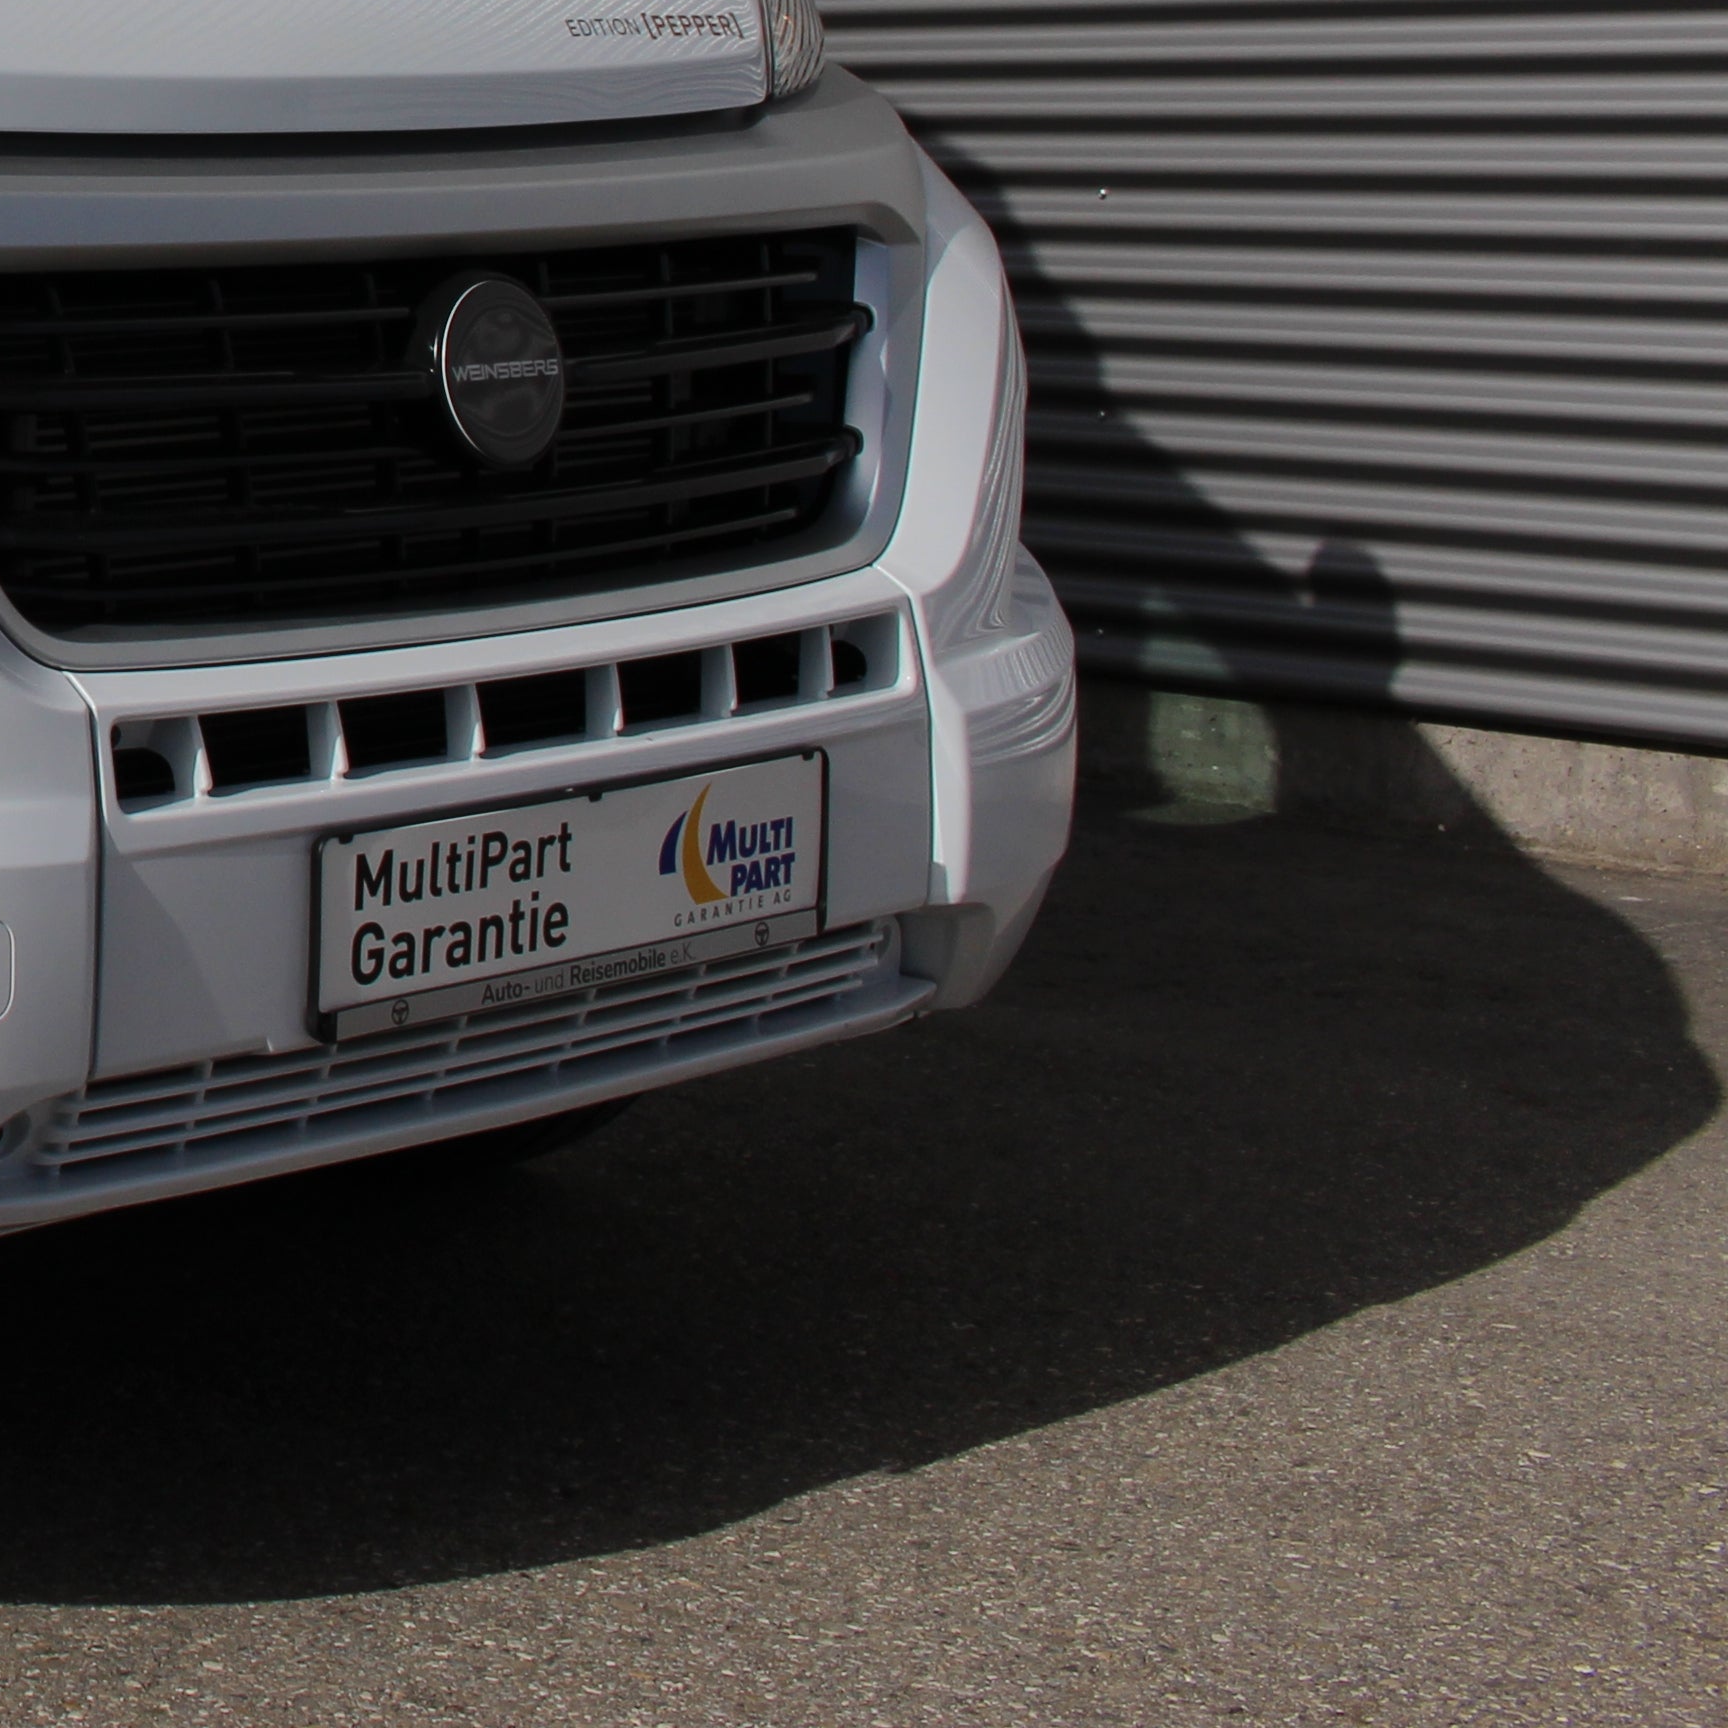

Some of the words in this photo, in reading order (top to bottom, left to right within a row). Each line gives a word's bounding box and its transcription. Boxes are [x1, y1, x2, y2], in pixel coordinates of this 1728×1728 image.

[564, 17, 641, 37] EDITION
[706, 816, 793, 866] MULTI
[354, 821, 573, 912] MultiPart
[730, 852, 796, 898] PART
[674, 895, 764, 927] GARANTIE
[773, 889, 792, 905] AG
[351, 892, 570, 986] Garantie
[481, 981, 531, 1005] Auto-
[534, 971, 565, 995] und
[570, 948, 666, 986] Reisemobile
